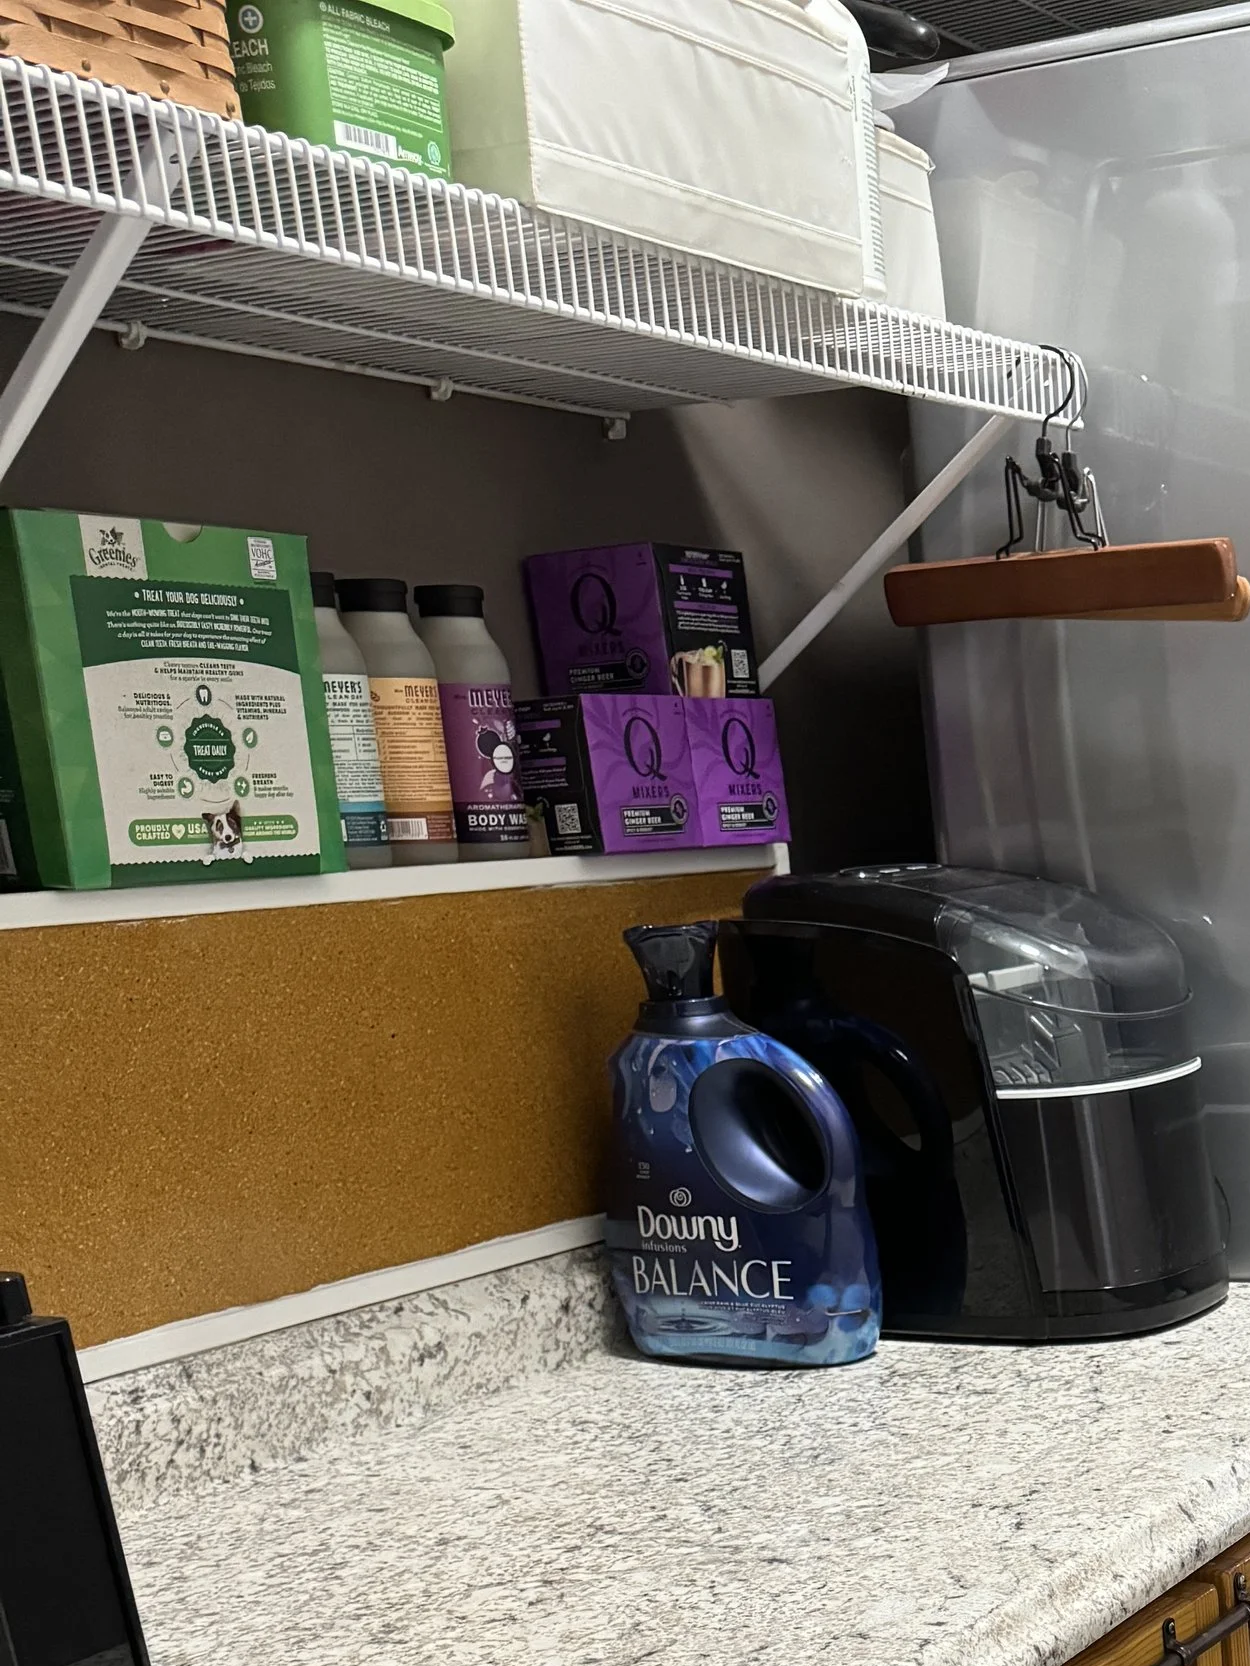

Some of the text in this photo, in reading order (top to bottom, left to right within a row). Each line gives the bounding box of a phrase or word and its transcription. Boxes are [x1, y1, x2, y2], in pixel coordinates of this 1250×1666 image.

[328, 4, 391, 33] ALL FABRIC BLEACH
[88, 547, 136, 568] Greenies
[251, 548, 272, 559] VOHC
[142, 589, 237, 607] TREAT YOUR DOG DELICIOUSLY
[570, 572, 622, 636] Q
[193, 744, 227, 756] TREAT DAILY
[624, 716, 667, 782] Q
[721, 717, 761, 779] Q
[632, 785, 670, 799] MIXERS
[728, 783, 762, 797] MIXERS
[467, 814, 506, 826] BODY
[624, 816, 662, 826] GINGER BEER
[721, 812, 754, 821] GINGER BEER
[135, 823, 208, 834] PROUDLY USA
[136, 832, 170, 840] CRAFTED
[637, 1205, 740, 1252] Downy
[641, 1240, 687, 1253] infusions
[632, 1255, 794, 1300] BALANCE
